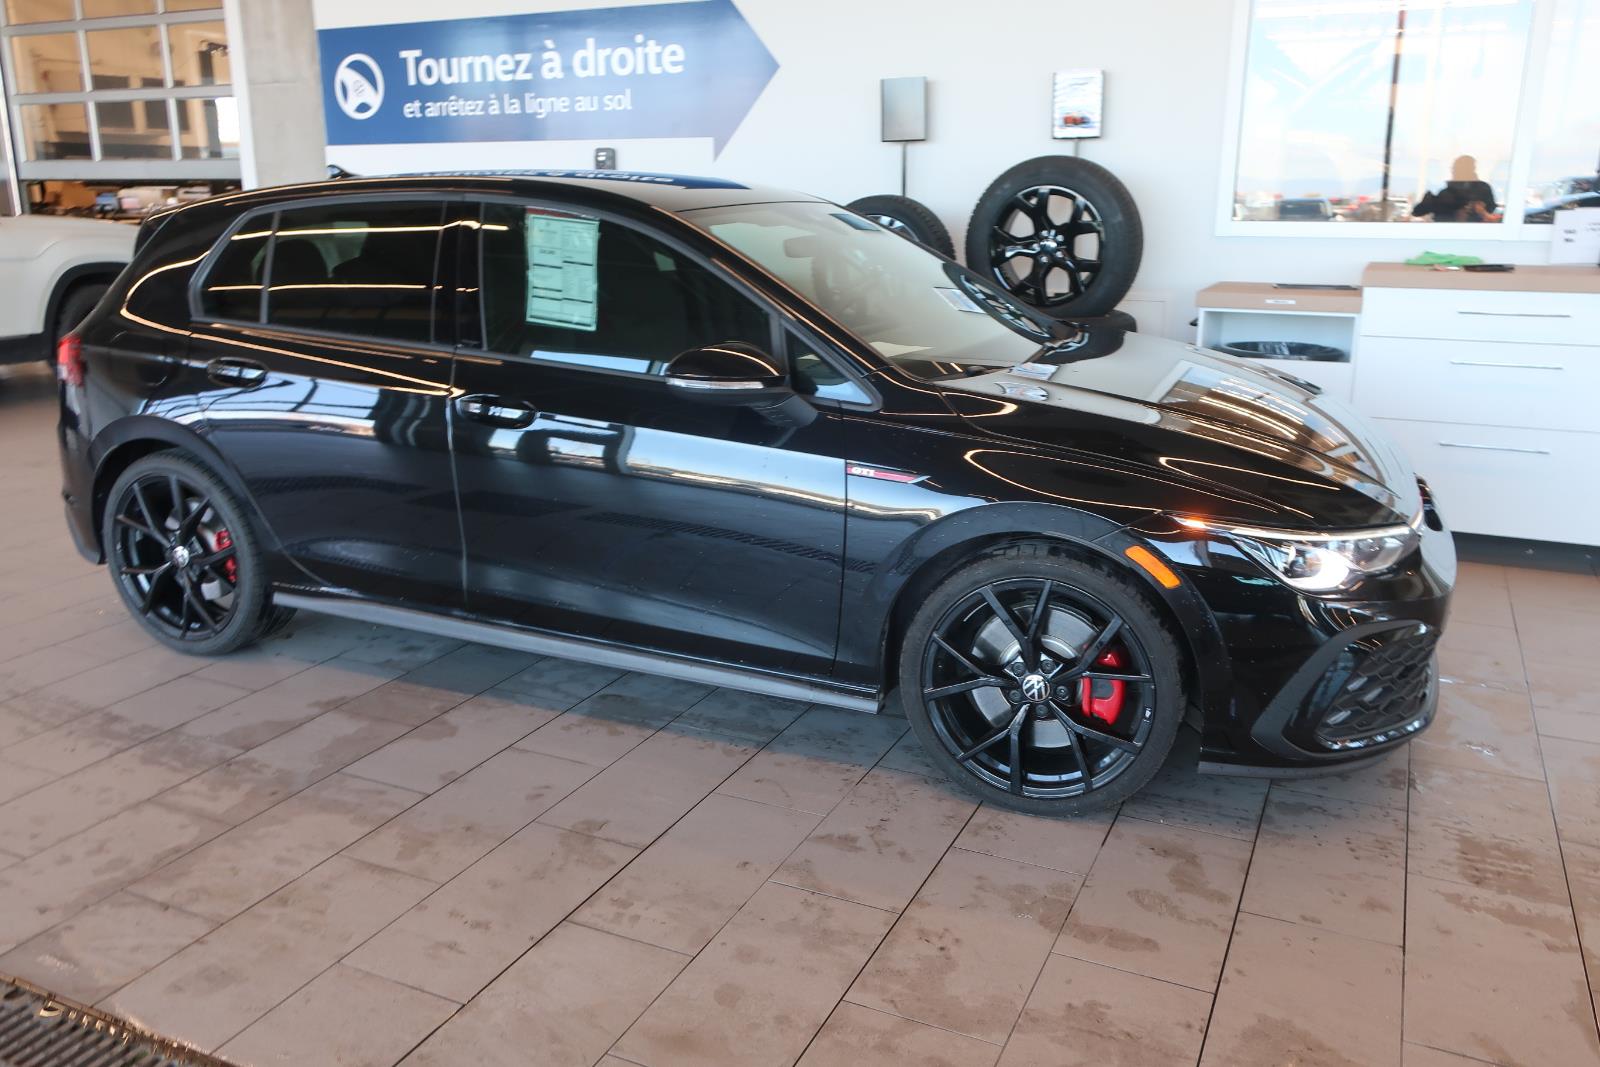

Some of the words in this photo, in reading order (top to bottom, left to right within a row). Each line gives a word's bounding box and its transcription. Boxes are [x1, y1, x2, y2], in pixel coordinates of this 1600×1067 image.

[399, 49, 533, 86] Tournez
[541, 39, 564, 79] à
[573, 33, 685, 78] droite
[403, 100, 423, 118] et
[425, 95, 485, 117] arrêtez
[488, 93, 501, 115] à
[504, 93, 522, 114] la
[525, 92, 570, 119] ligne
[574, 95, 599, 112] au
[603, 88, 633, 111] sol
